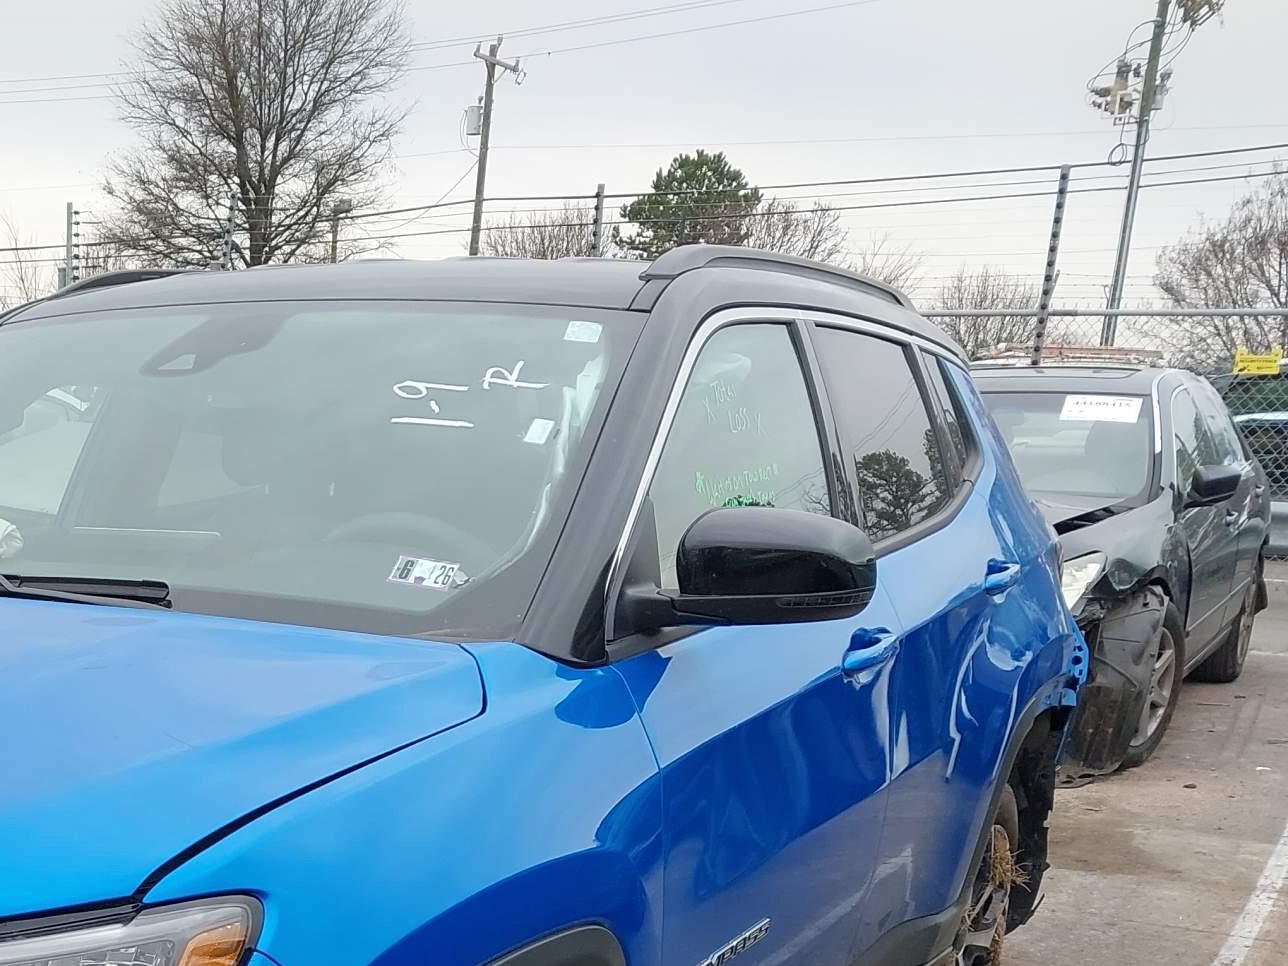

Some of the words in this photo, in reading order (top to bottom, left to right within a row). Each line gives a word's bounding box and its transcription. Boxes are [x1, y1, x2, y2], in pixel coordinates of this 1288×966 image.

[480, 359, 551, 390] R
[398, 559, 415, 580] 6
[433, 564, 455, 586] 26
